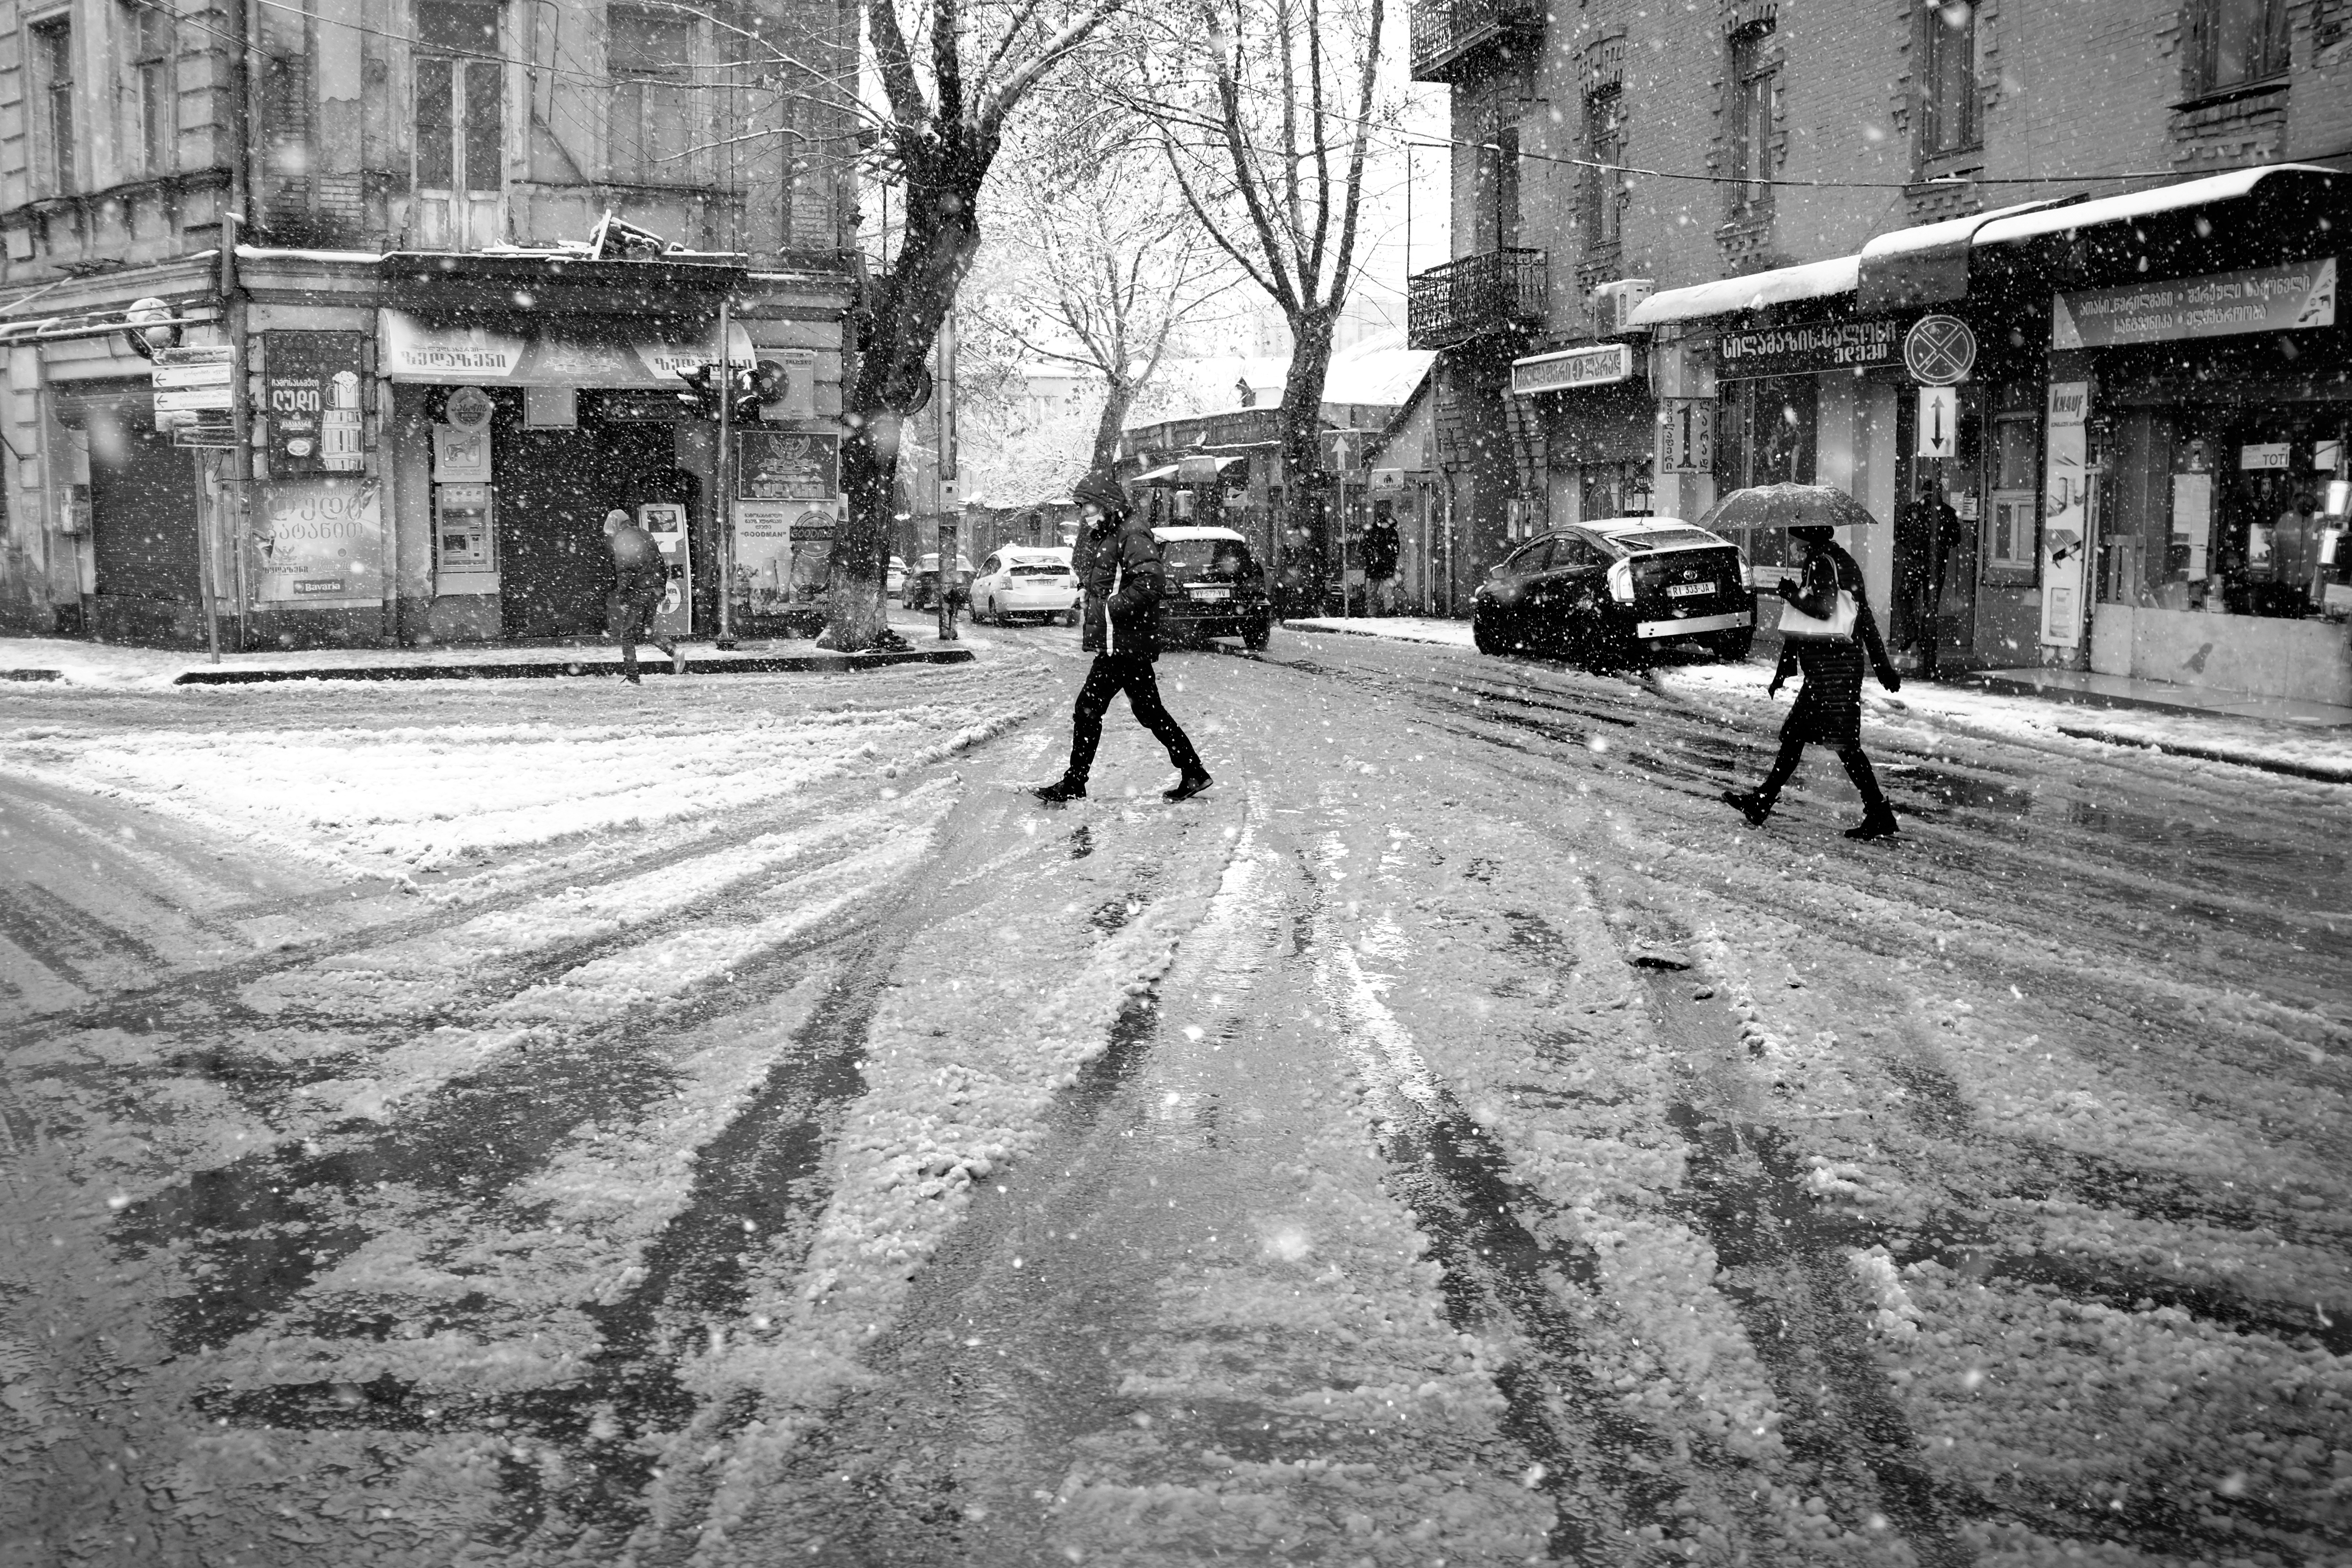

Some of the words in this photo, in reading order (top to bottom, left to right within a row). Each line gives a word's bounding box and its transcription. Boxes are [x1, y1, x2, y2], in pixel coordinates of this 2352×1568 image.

[2080, 298, 2110, 316] ათასი
[2114, 291, 2174, 312] წვრილმანი
[2188, 282, 2242, 303] შერეული
[2246, 275, 2311, 297] საქონელი
[2114, 314, 2173, 333] სანტექნიკა
[2187, 304, 2267, 326] ელექტროობა
[1723, 329, 1818, 358] სილამაზის
[1822, 319, 1897, 348] სალონი
[401, 351, 506, 368] ზედაზენი
[1834, 343, 1887, 363] ედემი
[1518, 362, 1570, 387] ყველაფერი
[1585, 354, 1621, 377] ლარად
[272, 379, 318, 387] ჩამოსასხმელი
[272, 390, 319, 411] ლუდი
[1677, 403, 1697, 468] 1
[2263, 453, 2288, 466] TOTI
[267, 497, 362, 521] ლუდი
[305, 583, 341, 592] Bavaria
[1673, 584, 1710, 596] RI333-JA
